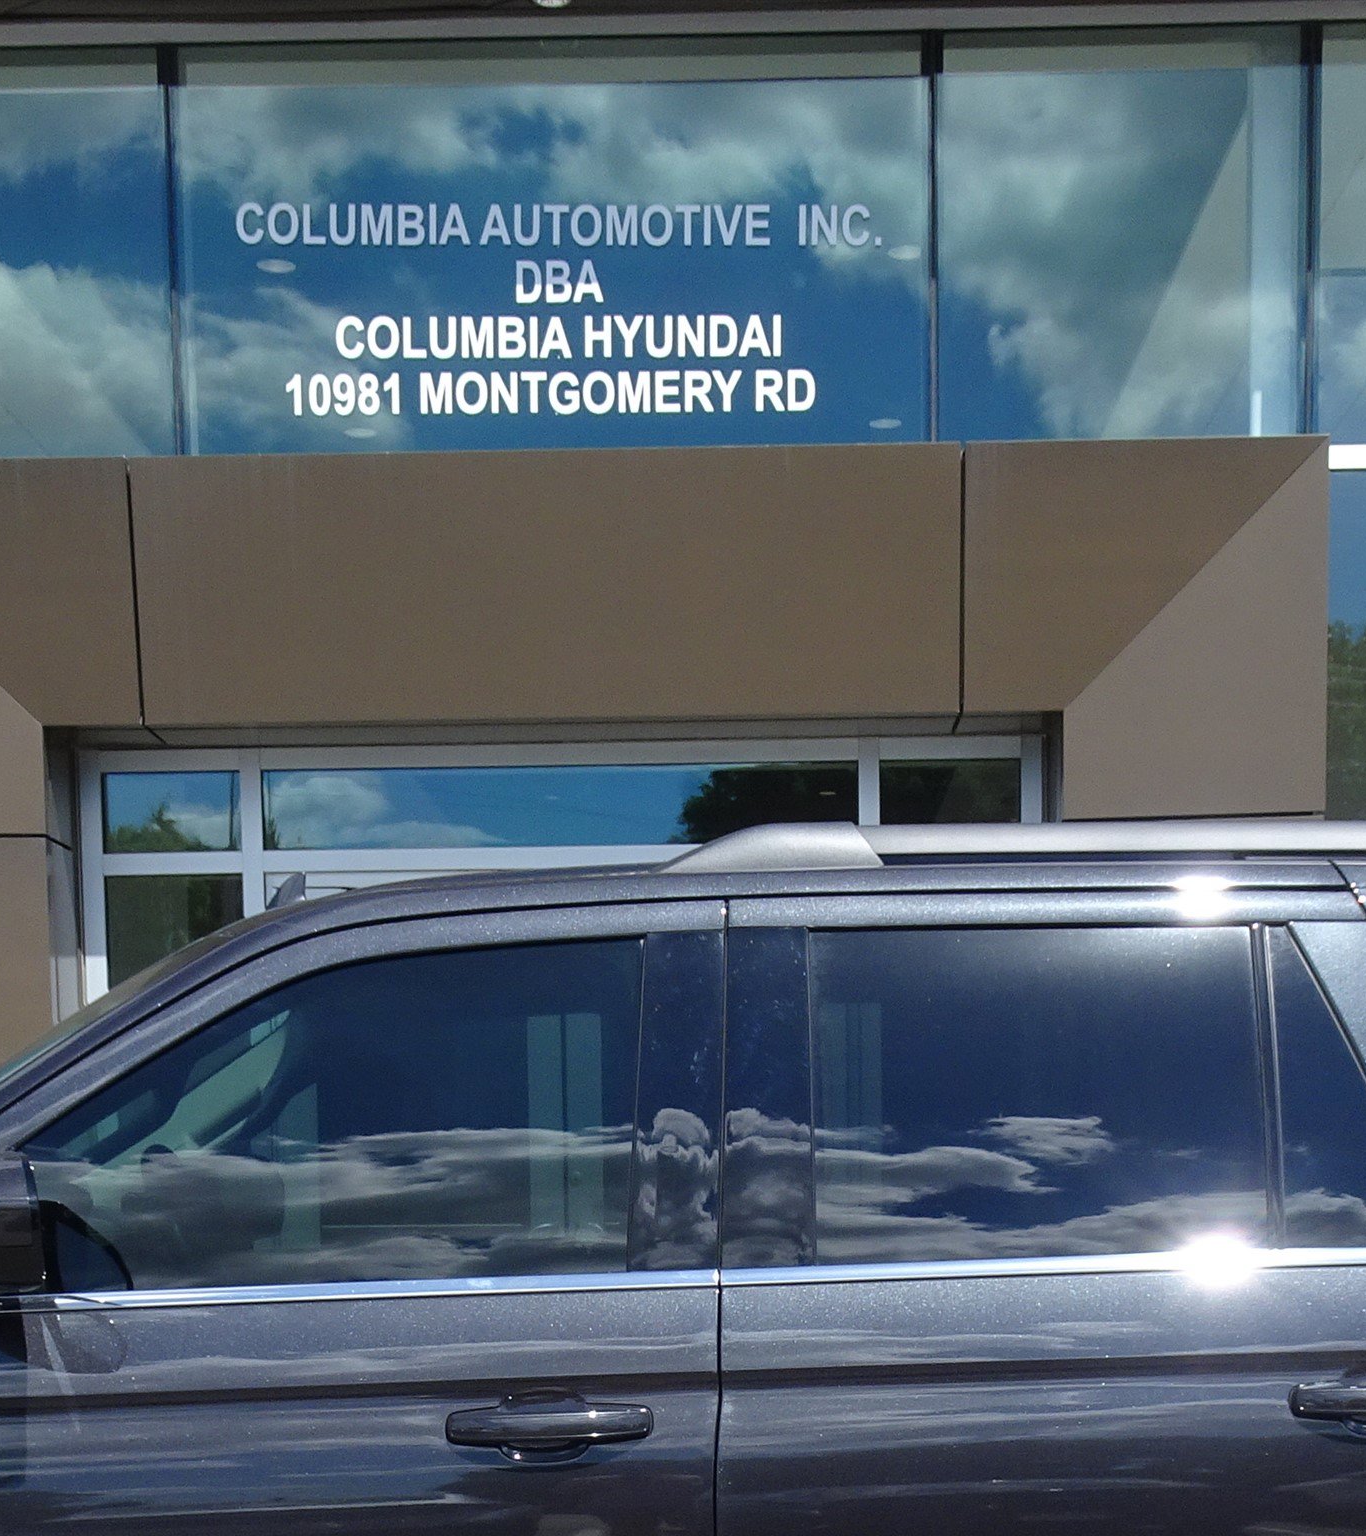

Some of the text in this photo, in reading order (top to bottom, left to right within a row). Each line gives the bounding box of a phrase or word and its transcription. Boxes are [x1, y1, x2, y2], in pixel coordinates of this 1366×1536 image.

[235, 203, 882, 247] COLUMBIA AUTOMOTIVE INC.
[515, 259, 604, 304] DBA
[335, 315, 782, 360] COLUMBIA HYUNDAI
[285, 369, 816, 415] 10981 MONTGOMERY RD
